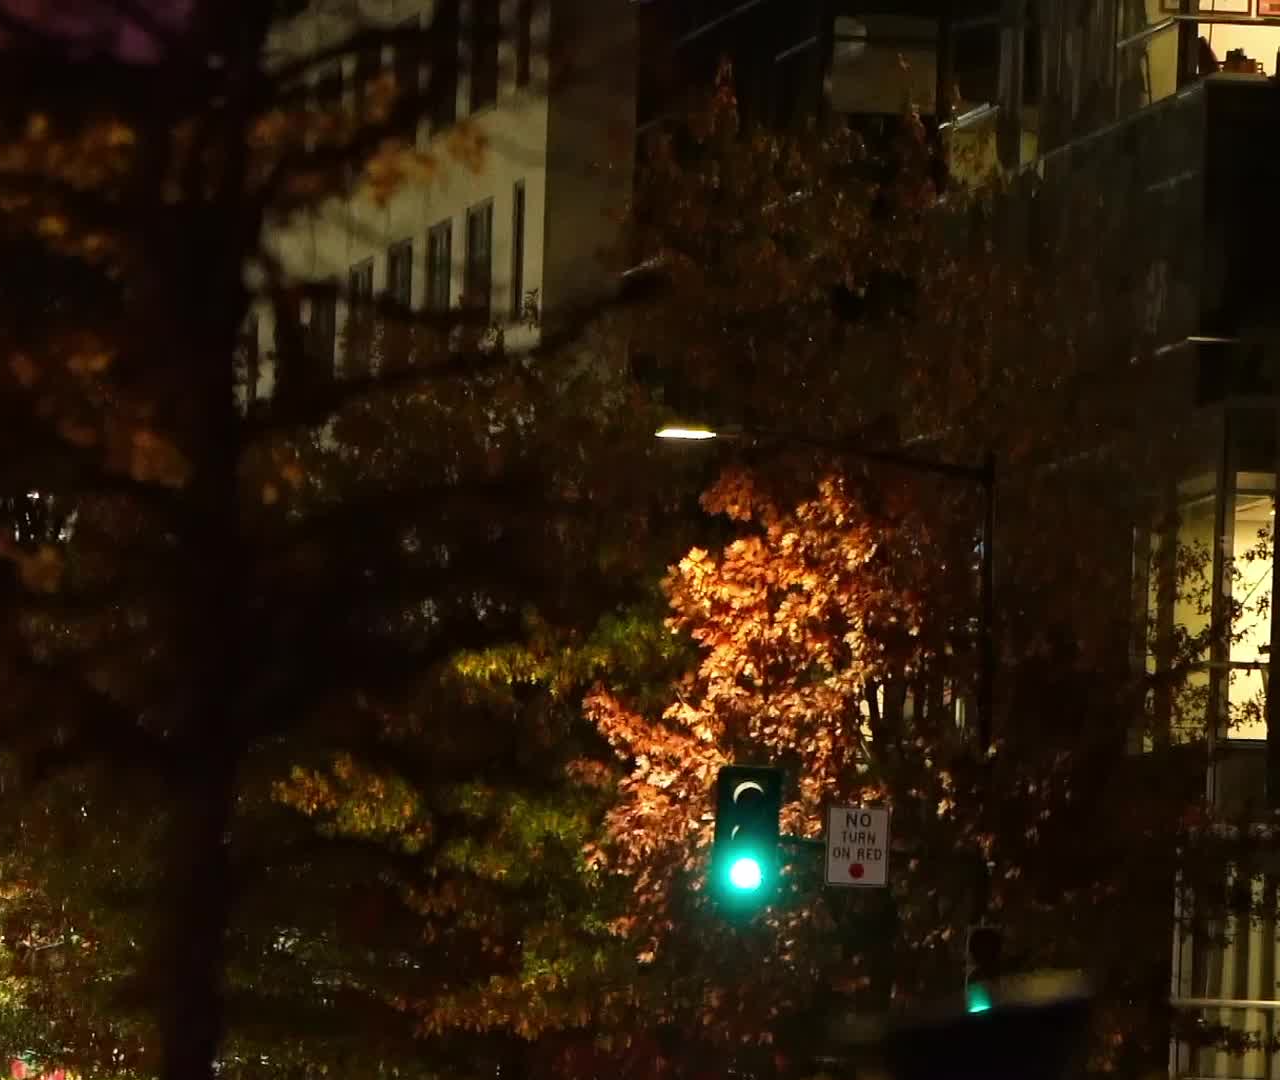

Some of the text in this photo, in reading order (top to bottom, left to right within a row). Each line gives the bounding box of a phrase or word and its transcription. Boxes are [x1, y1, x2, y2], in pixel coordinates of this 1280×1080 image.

[846, 813, 871, 828] NO
[841, 831, 876, 845] TURN
[832, 847, 883, 861] ON RED
